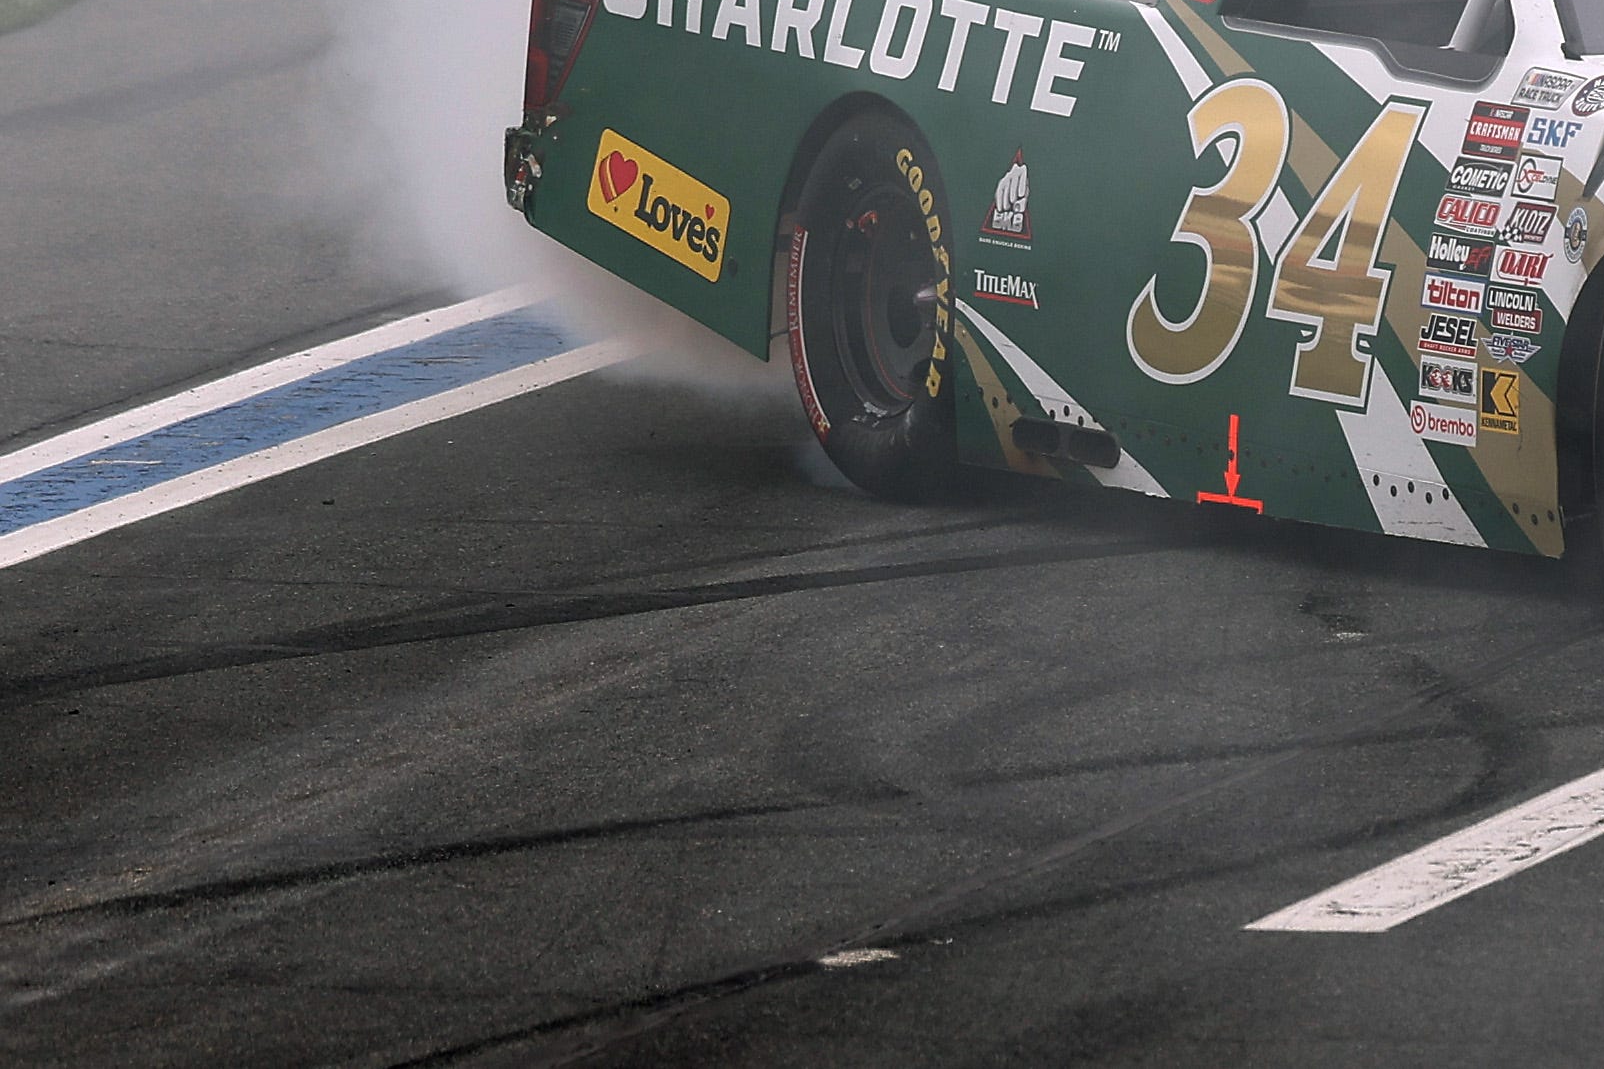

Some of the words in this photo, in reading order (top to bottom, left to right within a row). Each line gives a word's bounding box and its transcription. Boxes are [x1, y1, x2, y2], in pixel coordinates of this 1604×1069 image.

[1469, 121, 1521, 141] CRAFTSMAN
[1527, 118, 1582, 147] SKF
[1451, 166, 1508, 190] COMETIC
[1437, 196, 1500, 227] CALICO
[1511, 208, 1551, 234] KLOTZ
[1126, 78, 1426, 408] 34
[1429, 235, 1471, 270] Holley
[1501, 249, 1554, 278] DART
[1427, 279, 1480, 310] tilton
[1489, 290, 1534, 312] LINCOLN
[1421, 314, 1478, 347] JESEL
[1497, 312, 1536, 329] WELDERS
[1428, 413, 1474, 436] brembo
